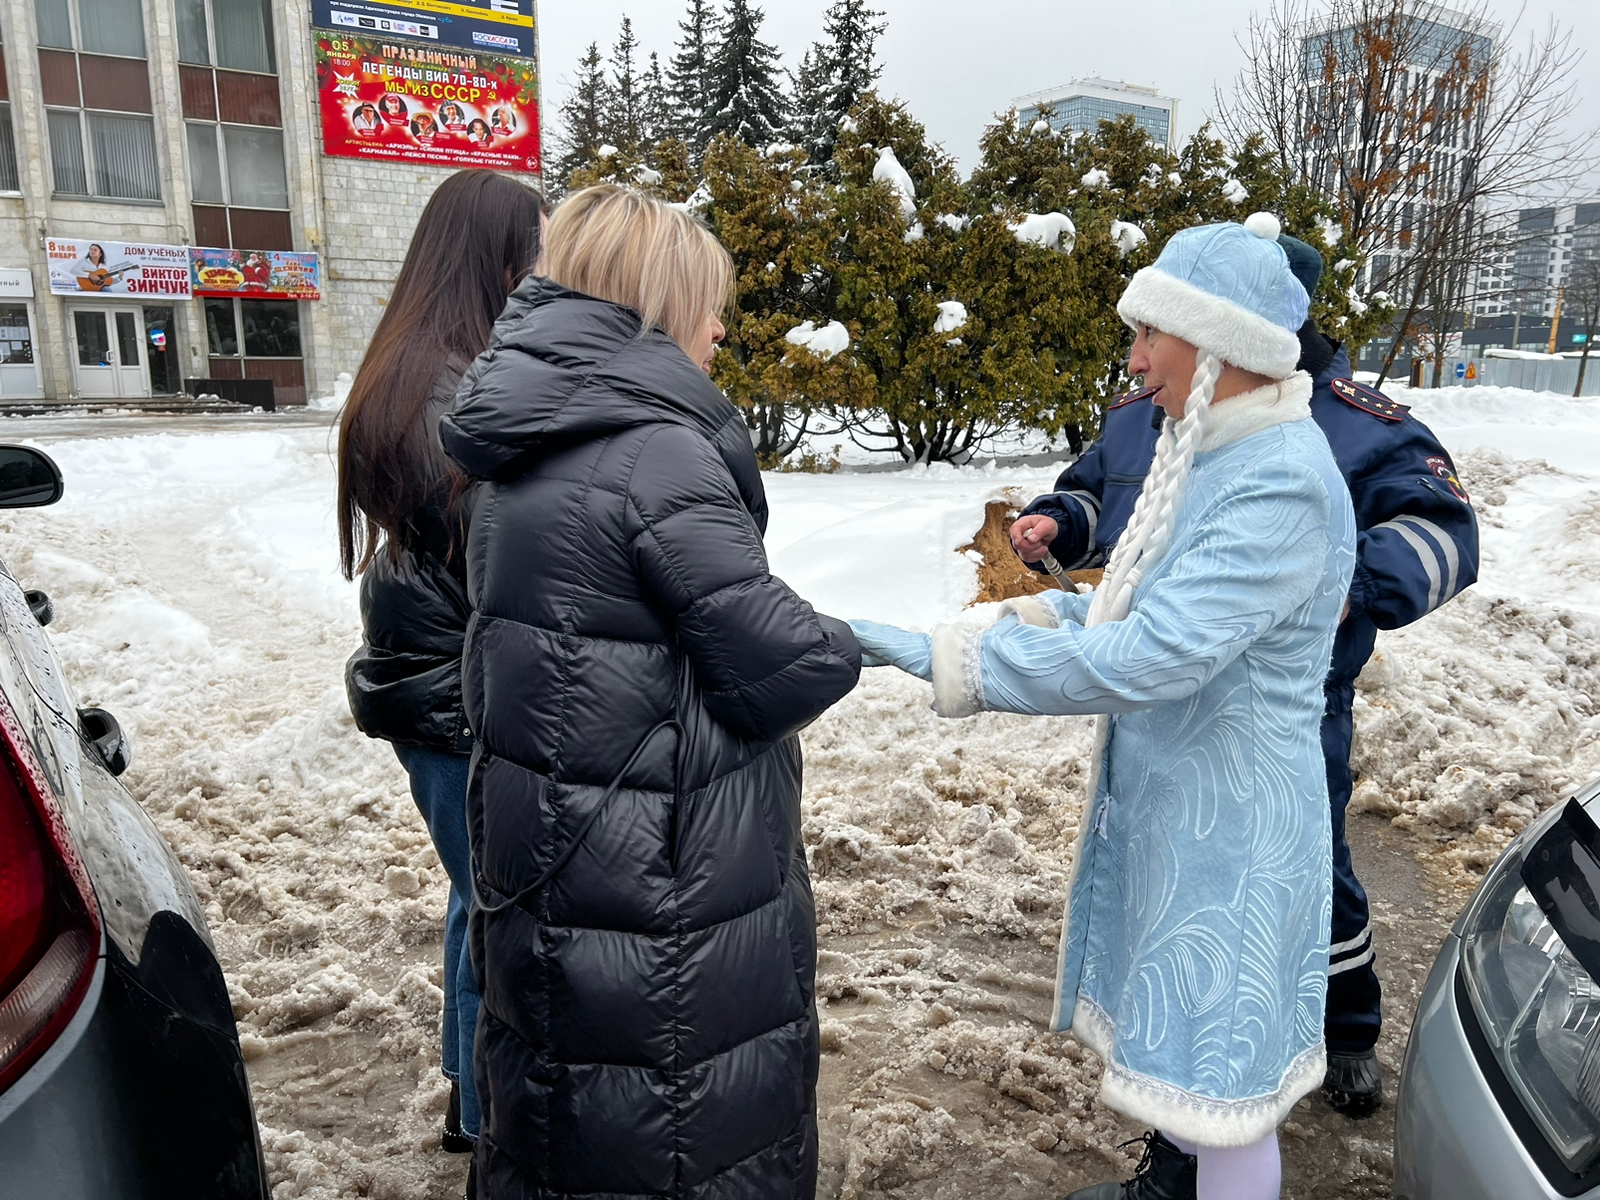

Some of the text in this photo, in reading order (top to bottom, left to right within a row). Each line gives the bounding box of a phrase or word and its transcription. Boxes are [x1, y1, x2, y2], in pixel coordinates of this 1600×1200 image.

[331, 40, 349, 51] 05
[326, 50, 357, 60] ЯНВАРЯ
[381, 44, 477, 70] ПРАЗДНИЧНЫЙ
[333, 58, 351, 67] 18:00
[362, 61, 422, 80] ЛЕГЕНДЫ
[425, 70, 449, 84] ВИА
[385, 81, 481, 103] МЫ ИЗ СССР
[48, 241, 76, 252] 8 18:00
[124, 246, 187, 258] ДОМ УЧЁНЫХ
[49, 252, 77, 260] ЯНВАРЯ
[142, 268, 188, 280] ВИКТОР
[204, 268, 238, 280] ЦИРК
[126, 278, 190, 294] ЗИНЧУК
